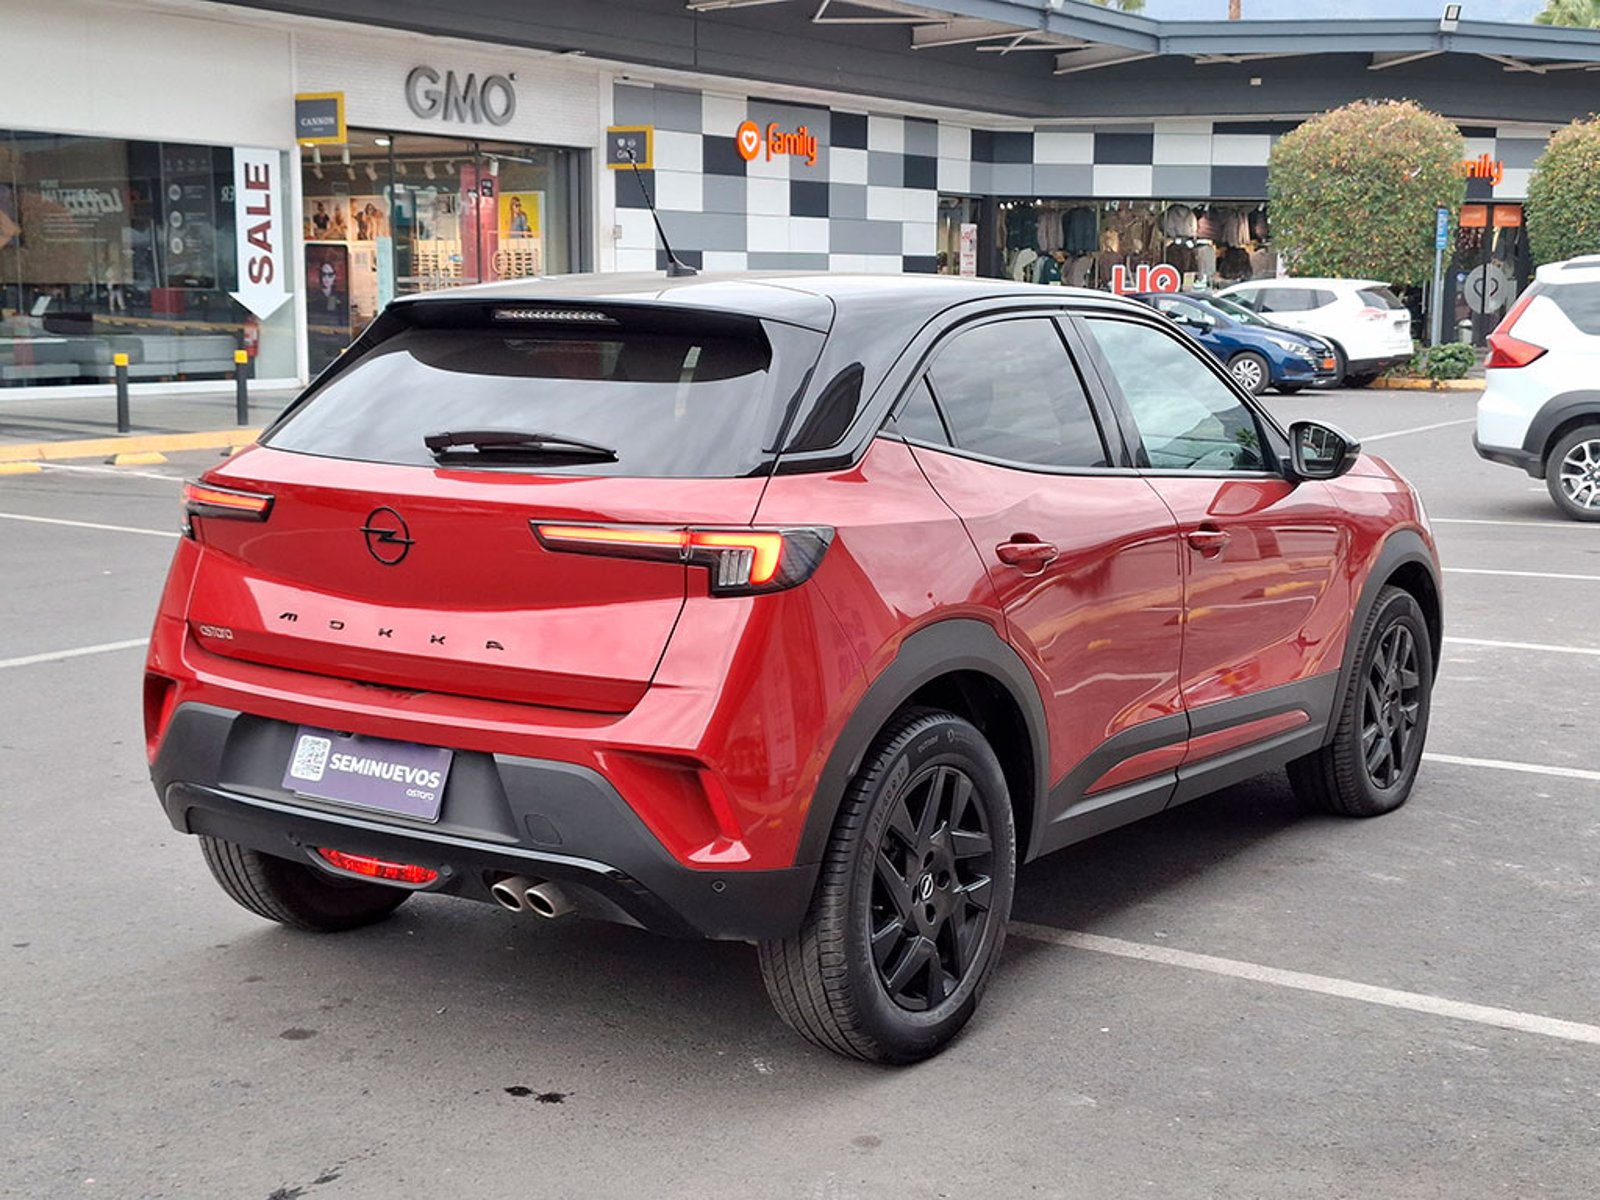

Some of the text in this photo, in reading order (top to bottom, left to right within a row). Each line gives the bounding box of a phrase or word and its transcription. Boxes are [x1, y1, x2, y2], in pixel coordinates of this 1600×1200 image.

[405, 65, 517, 125] GMO
[765, 122, 818, 166] family
[244, 162, 274, 285] SALE
[1112, 264, 1181, 296] LIQ
[279, 611, 505, 652] MOKKA
[329, 752, 441, 789] SEMINUEVOS
